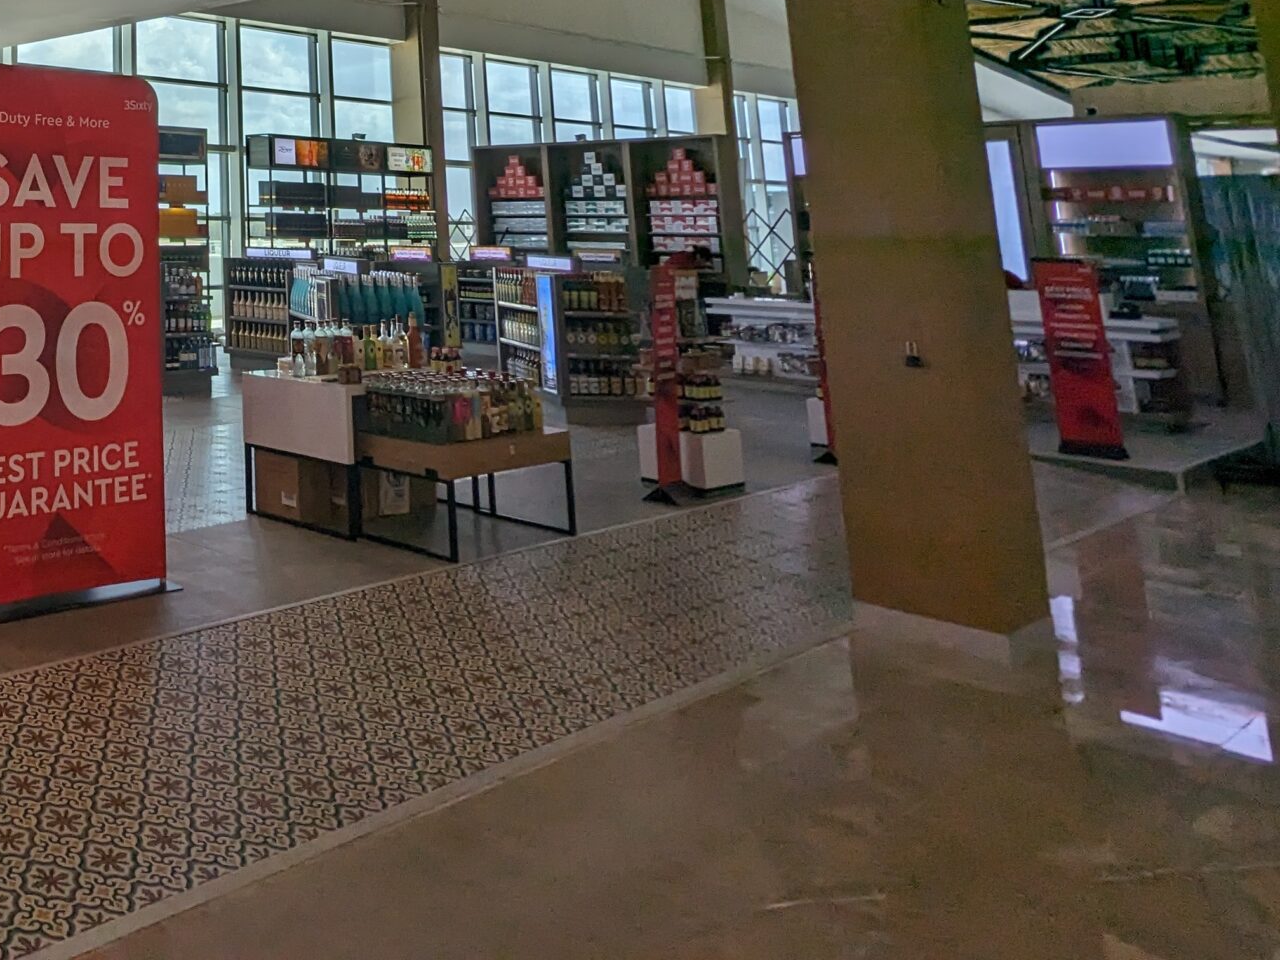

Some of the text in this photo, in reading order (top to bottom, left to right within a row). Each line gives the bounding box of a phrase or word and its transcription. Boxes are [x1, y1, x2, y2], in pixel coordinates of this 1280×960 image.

[124, 100, 152, 113] 3Sixty
[0, 111, 111, 129] Duty Free & More
[60, 222, 145, 278] TO
[264, 249, 291, 257] LIQUEUR
[54, 441, 141, 478] PRICE
